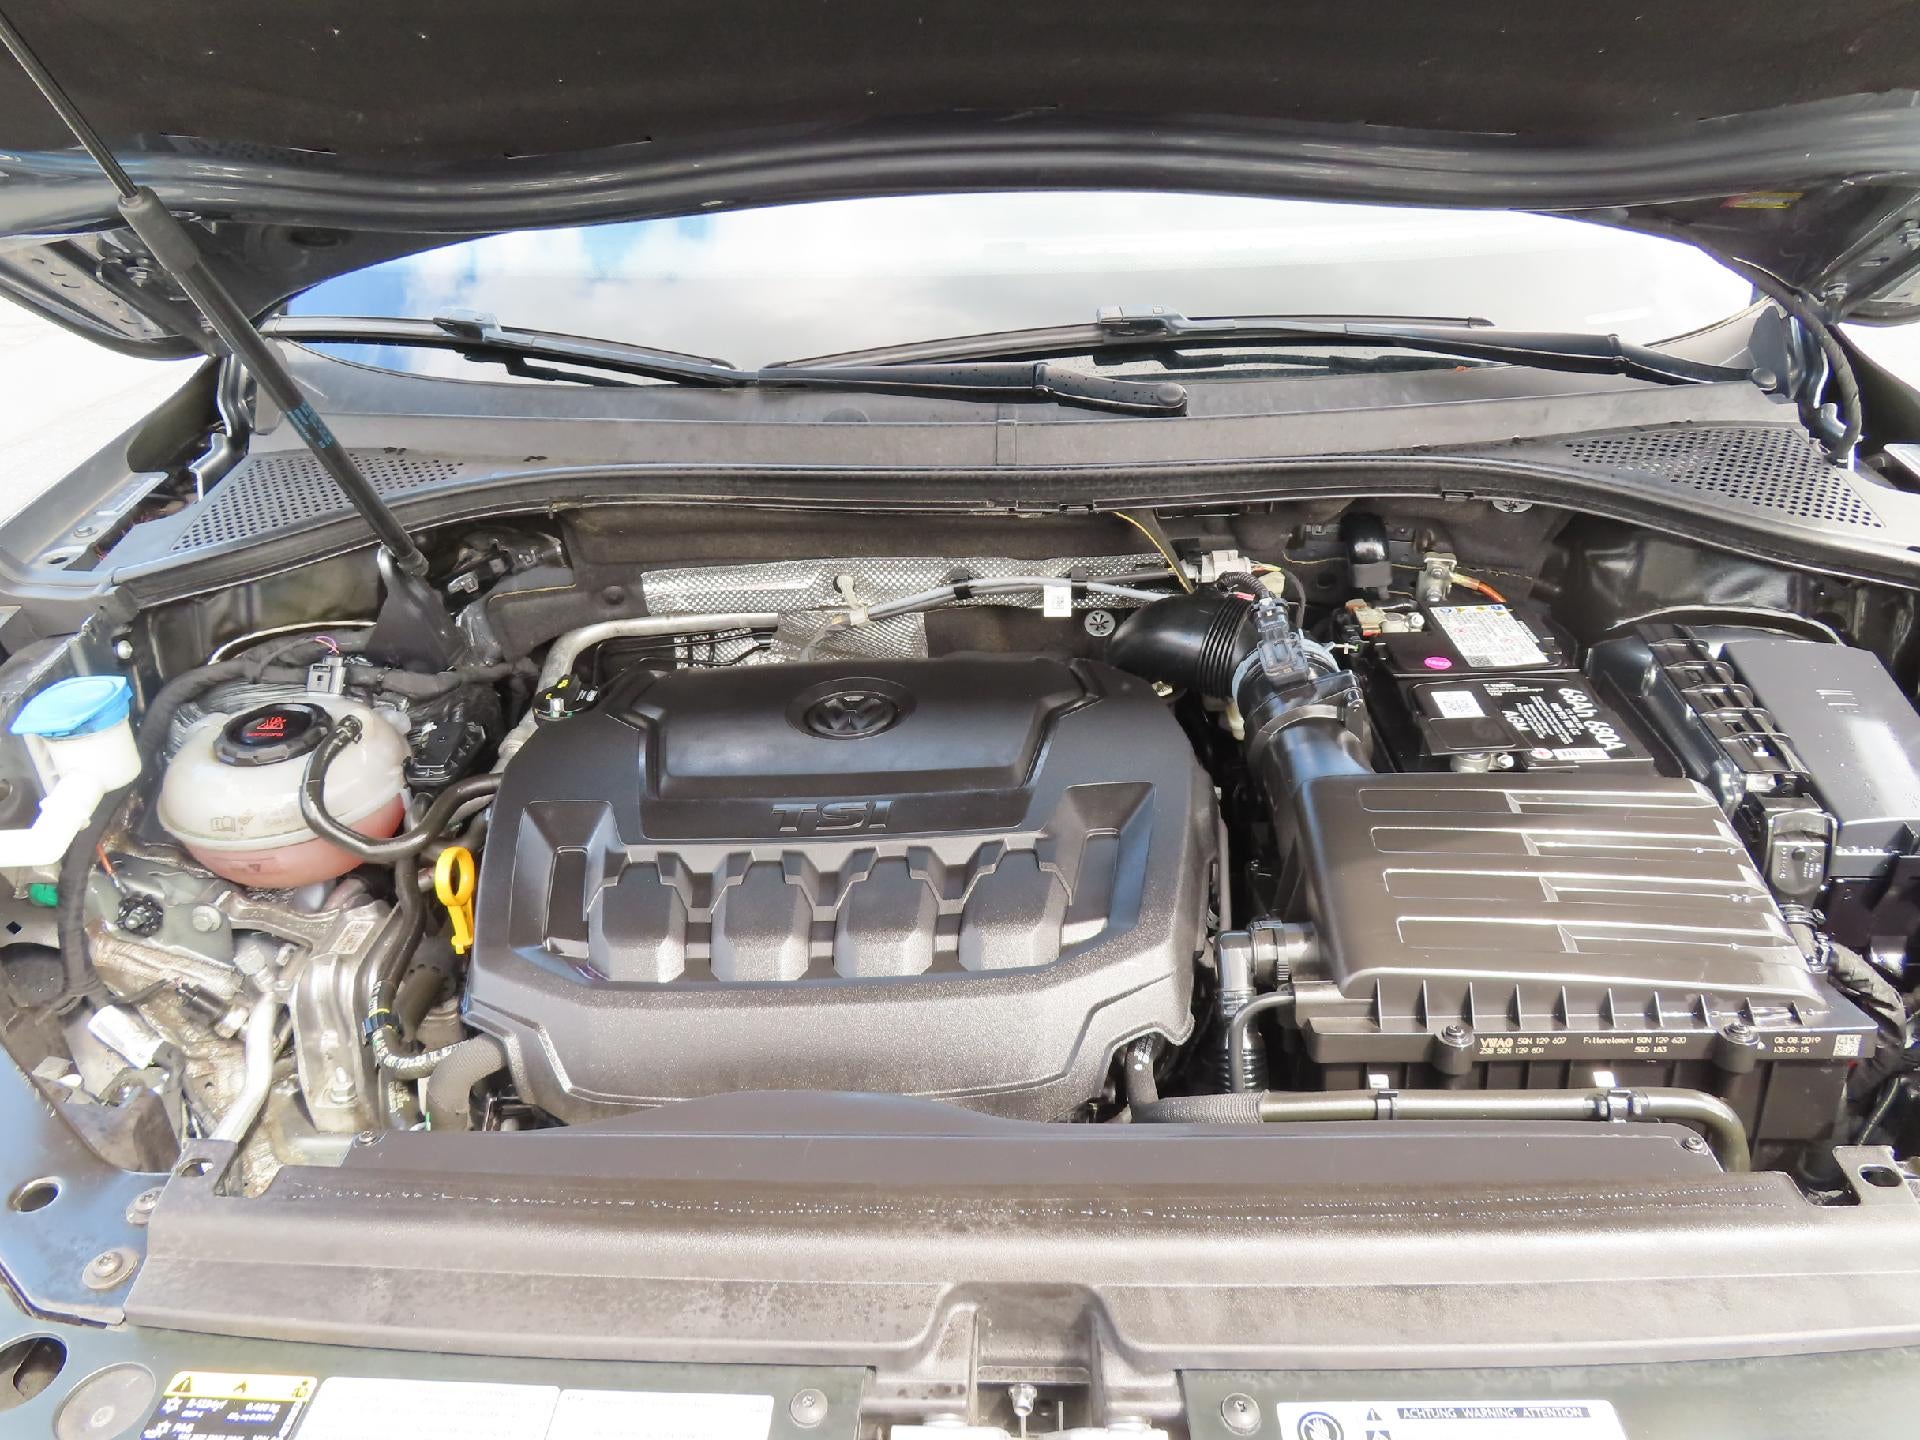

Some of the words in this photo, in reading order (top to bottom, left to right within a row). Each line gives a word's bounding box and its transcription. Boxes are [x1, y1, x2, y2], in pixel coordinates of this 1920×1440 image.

[1501, 711, 1531, 731] AGM
[1558, 688, 1598, 717] 68Ah
[1584, 720, 1627, 750] 680A
[772, 800, 894, 831] TSI
[1535, 1037, 1550, 1045] 129
[1655, 1036, 1669, 1044] 129
[1401, 1408, 1457, 1419] ACHTUNG
[1461, 1407, 1518, 1418] WARNING
[1522, 1407, 1583, 1417] ATTENTION
